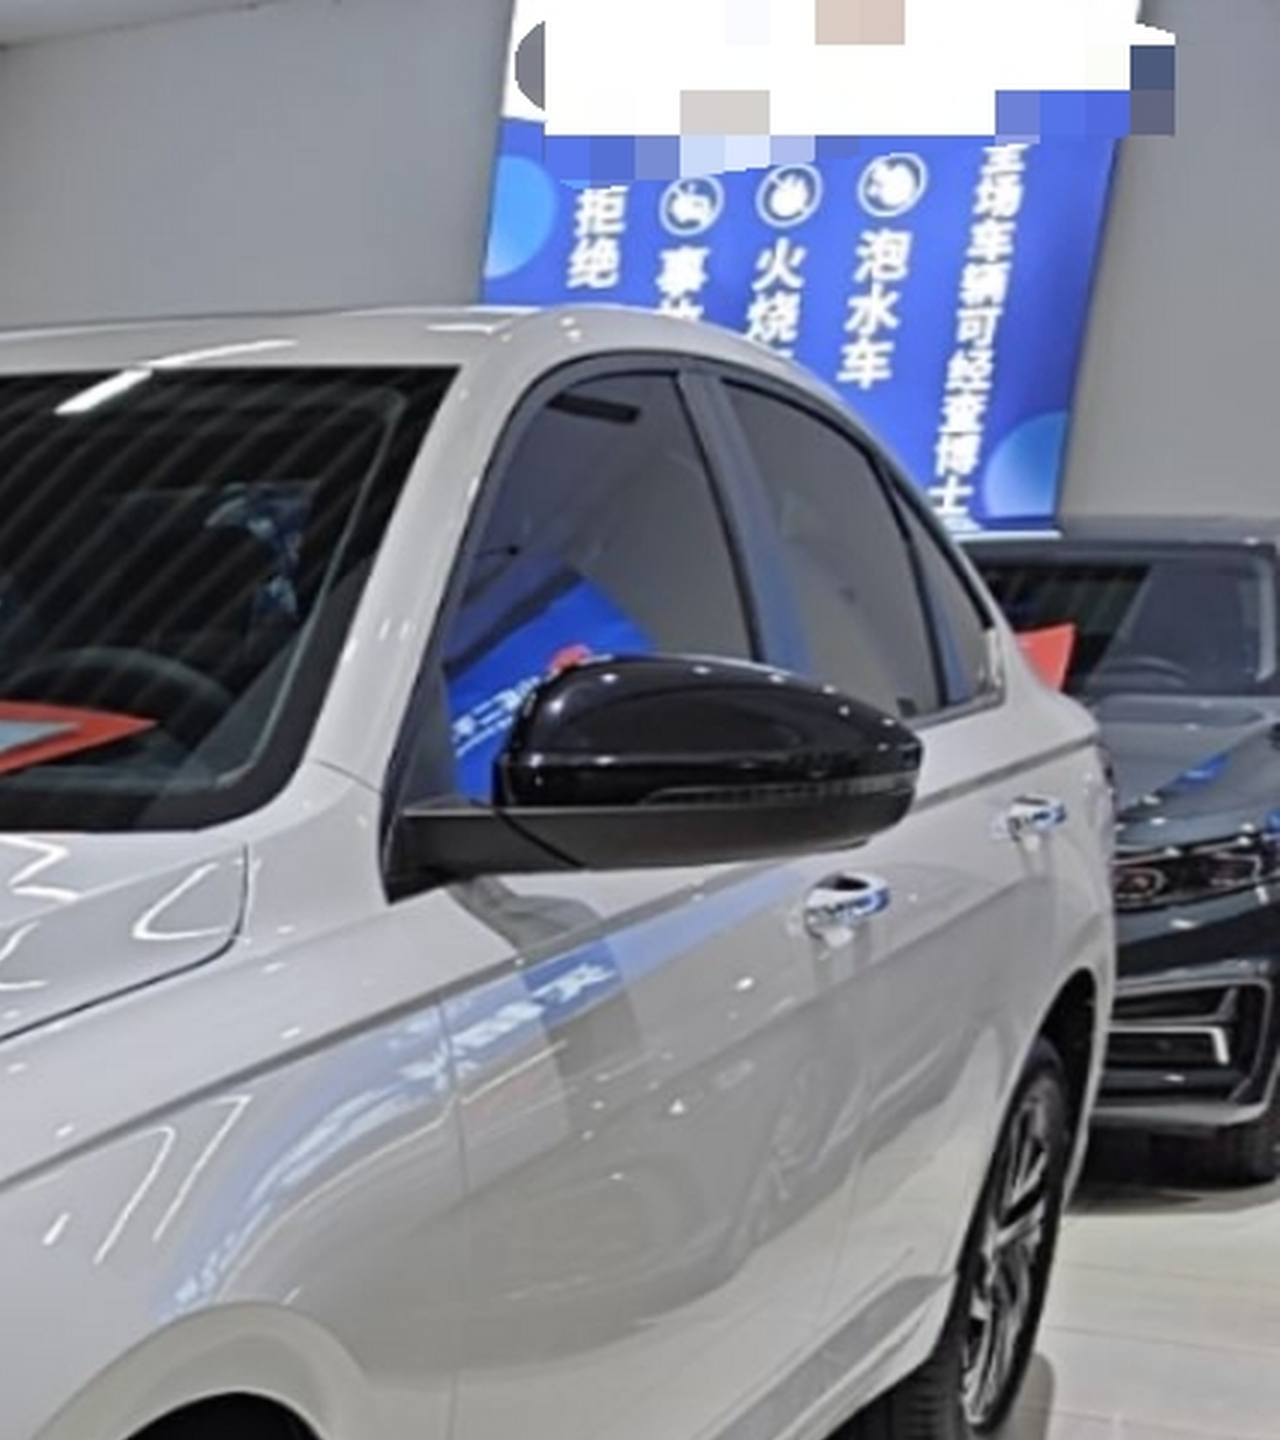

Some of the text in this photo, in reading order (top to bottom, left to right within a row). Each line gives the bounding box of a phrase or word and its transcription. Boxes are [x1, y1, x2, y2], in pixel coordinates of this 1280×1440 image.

[566, 185, 629, 289] 拒绝
[743, 237, 807, 358] 火烧
[837, 229, 913, 390] 泡水车
